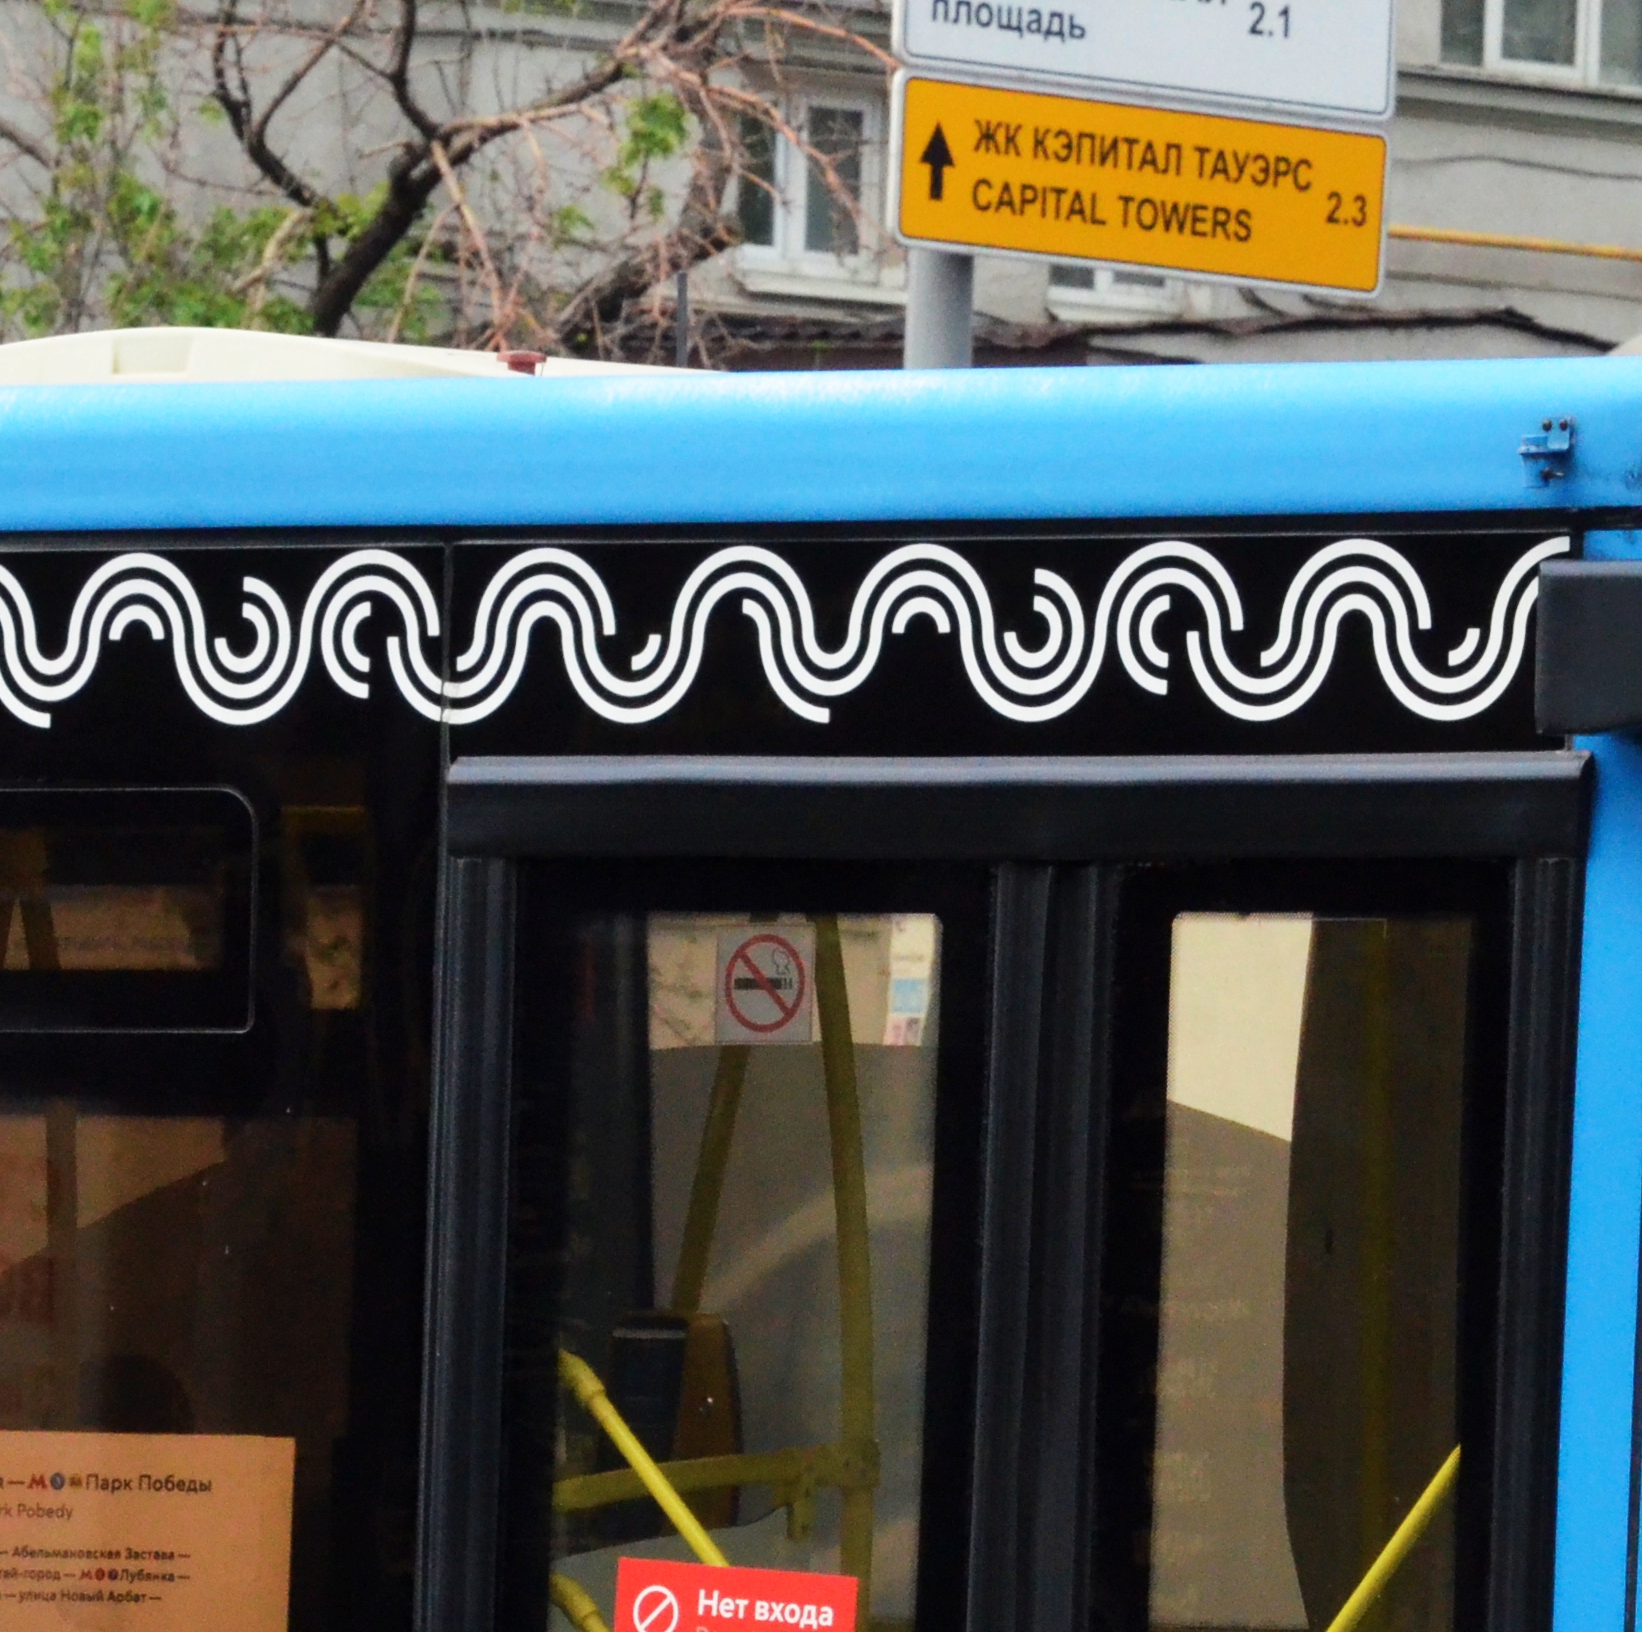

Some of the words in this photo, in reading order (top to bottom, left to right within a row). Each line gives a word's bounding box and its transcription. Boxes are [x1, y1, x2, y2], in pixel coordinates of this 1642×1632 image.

[931, 0, 1087, 42] площадь
[1249, 2, 1290, 38] 2.1
[973, 119, 1023, 159] ЖК
[1033, 128, 1183, 177] КЭПИТАЛ
[1195, 146, 1313, 193] ТАУЭРС
[972, 179, 1107, 226] CAPITAL
[1119, 194, 1253, 243] TOWERS
[1325, 191, 1368, 228] 2.3
[85, 1473, 134, 1494] Парк
[138, 1474, 213, 1494] Победы
[16, 1503, 74, 1521] Pobedy
[697, 1588, 749, 1619] Нет
[754, 1600, 834, 1630] входа
